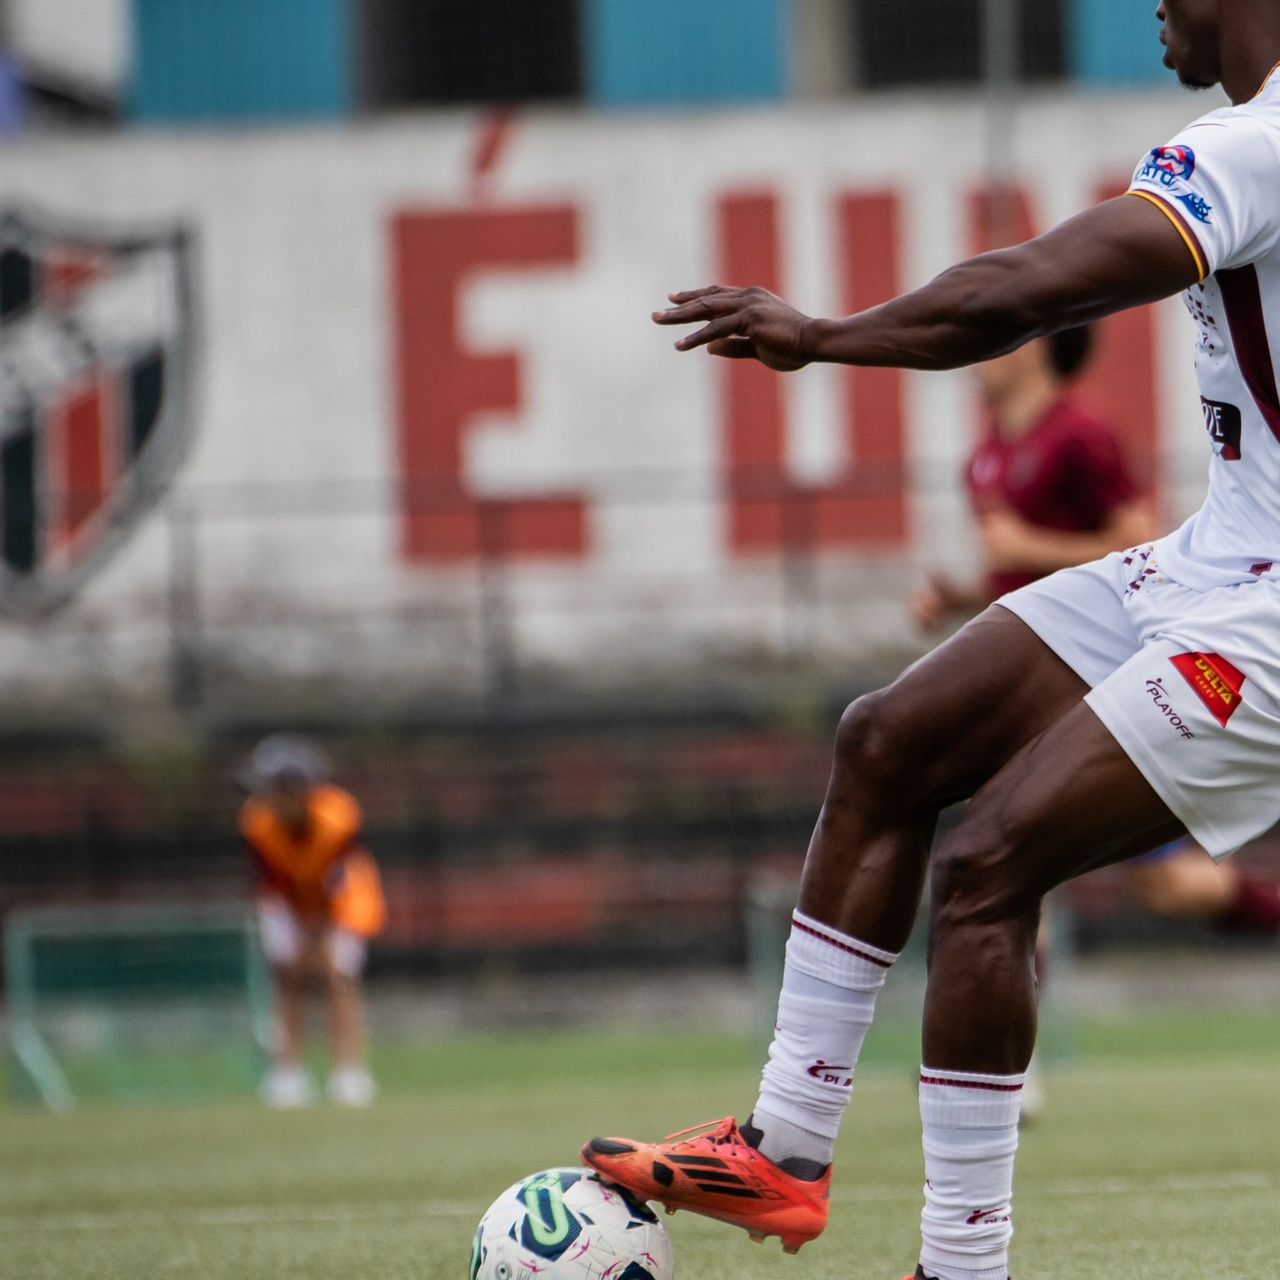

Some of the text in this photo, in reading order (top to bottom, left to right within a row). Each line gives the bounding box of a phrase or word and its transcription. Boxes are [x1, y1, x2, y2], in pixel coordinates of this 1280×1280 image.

[390, 111, 590, 562] É
[1195, 658, 1233, 705] DELTA
[1146, 687, 1194, 739] PLAYOFF
